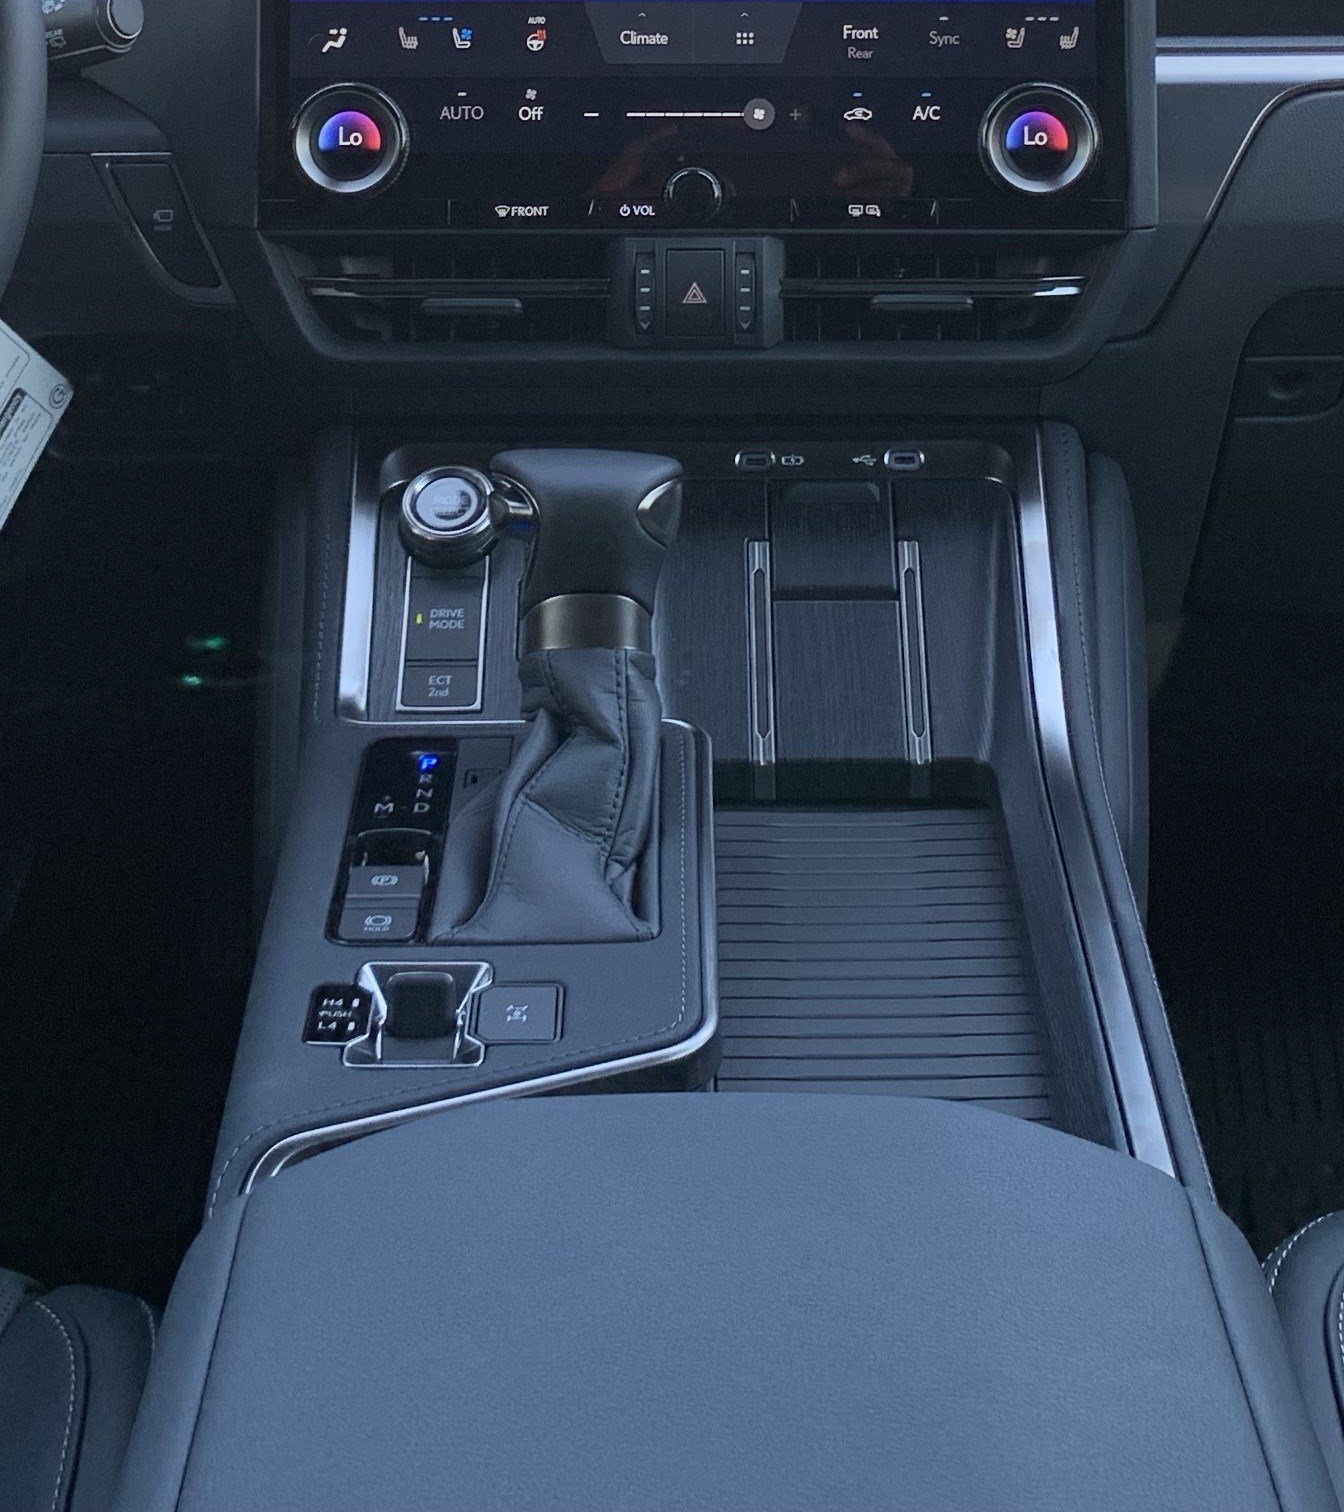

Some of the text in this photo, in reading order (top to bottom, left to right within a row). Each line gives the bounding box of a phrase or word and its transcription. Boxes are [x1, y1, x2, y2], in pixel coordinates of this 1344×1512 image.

[620, 30, 669, 47] Climate
[842, 25, 879, 42] Front
[929, 30, 960, 47] Sync
[847, 47, 874, 60] Rear
[440, 106, 485, 121] AUTO
[518, 105, 544, 122] Off
[912, 105, 941, 122] A/C
[338, 127, 363, 147] Lo
[1022, 127, 1048, 147] Lo
[511, 205, 549, 218] FRONT
[632, 205, 655, 217] VOL
[430, 609, 465, 618] DRIVE
[429, 620, 465, 629] MODE
[428, 675, 452, 685] ECT
[428, 687, 449, 697] 2nd
[420, 755, 438, 771] P
[416, 788, 433, 799] N
[373, 801, 430, 814] M D
[322, 998, 343, 1007] H4
[318, 1021, 337, 1031] L4
